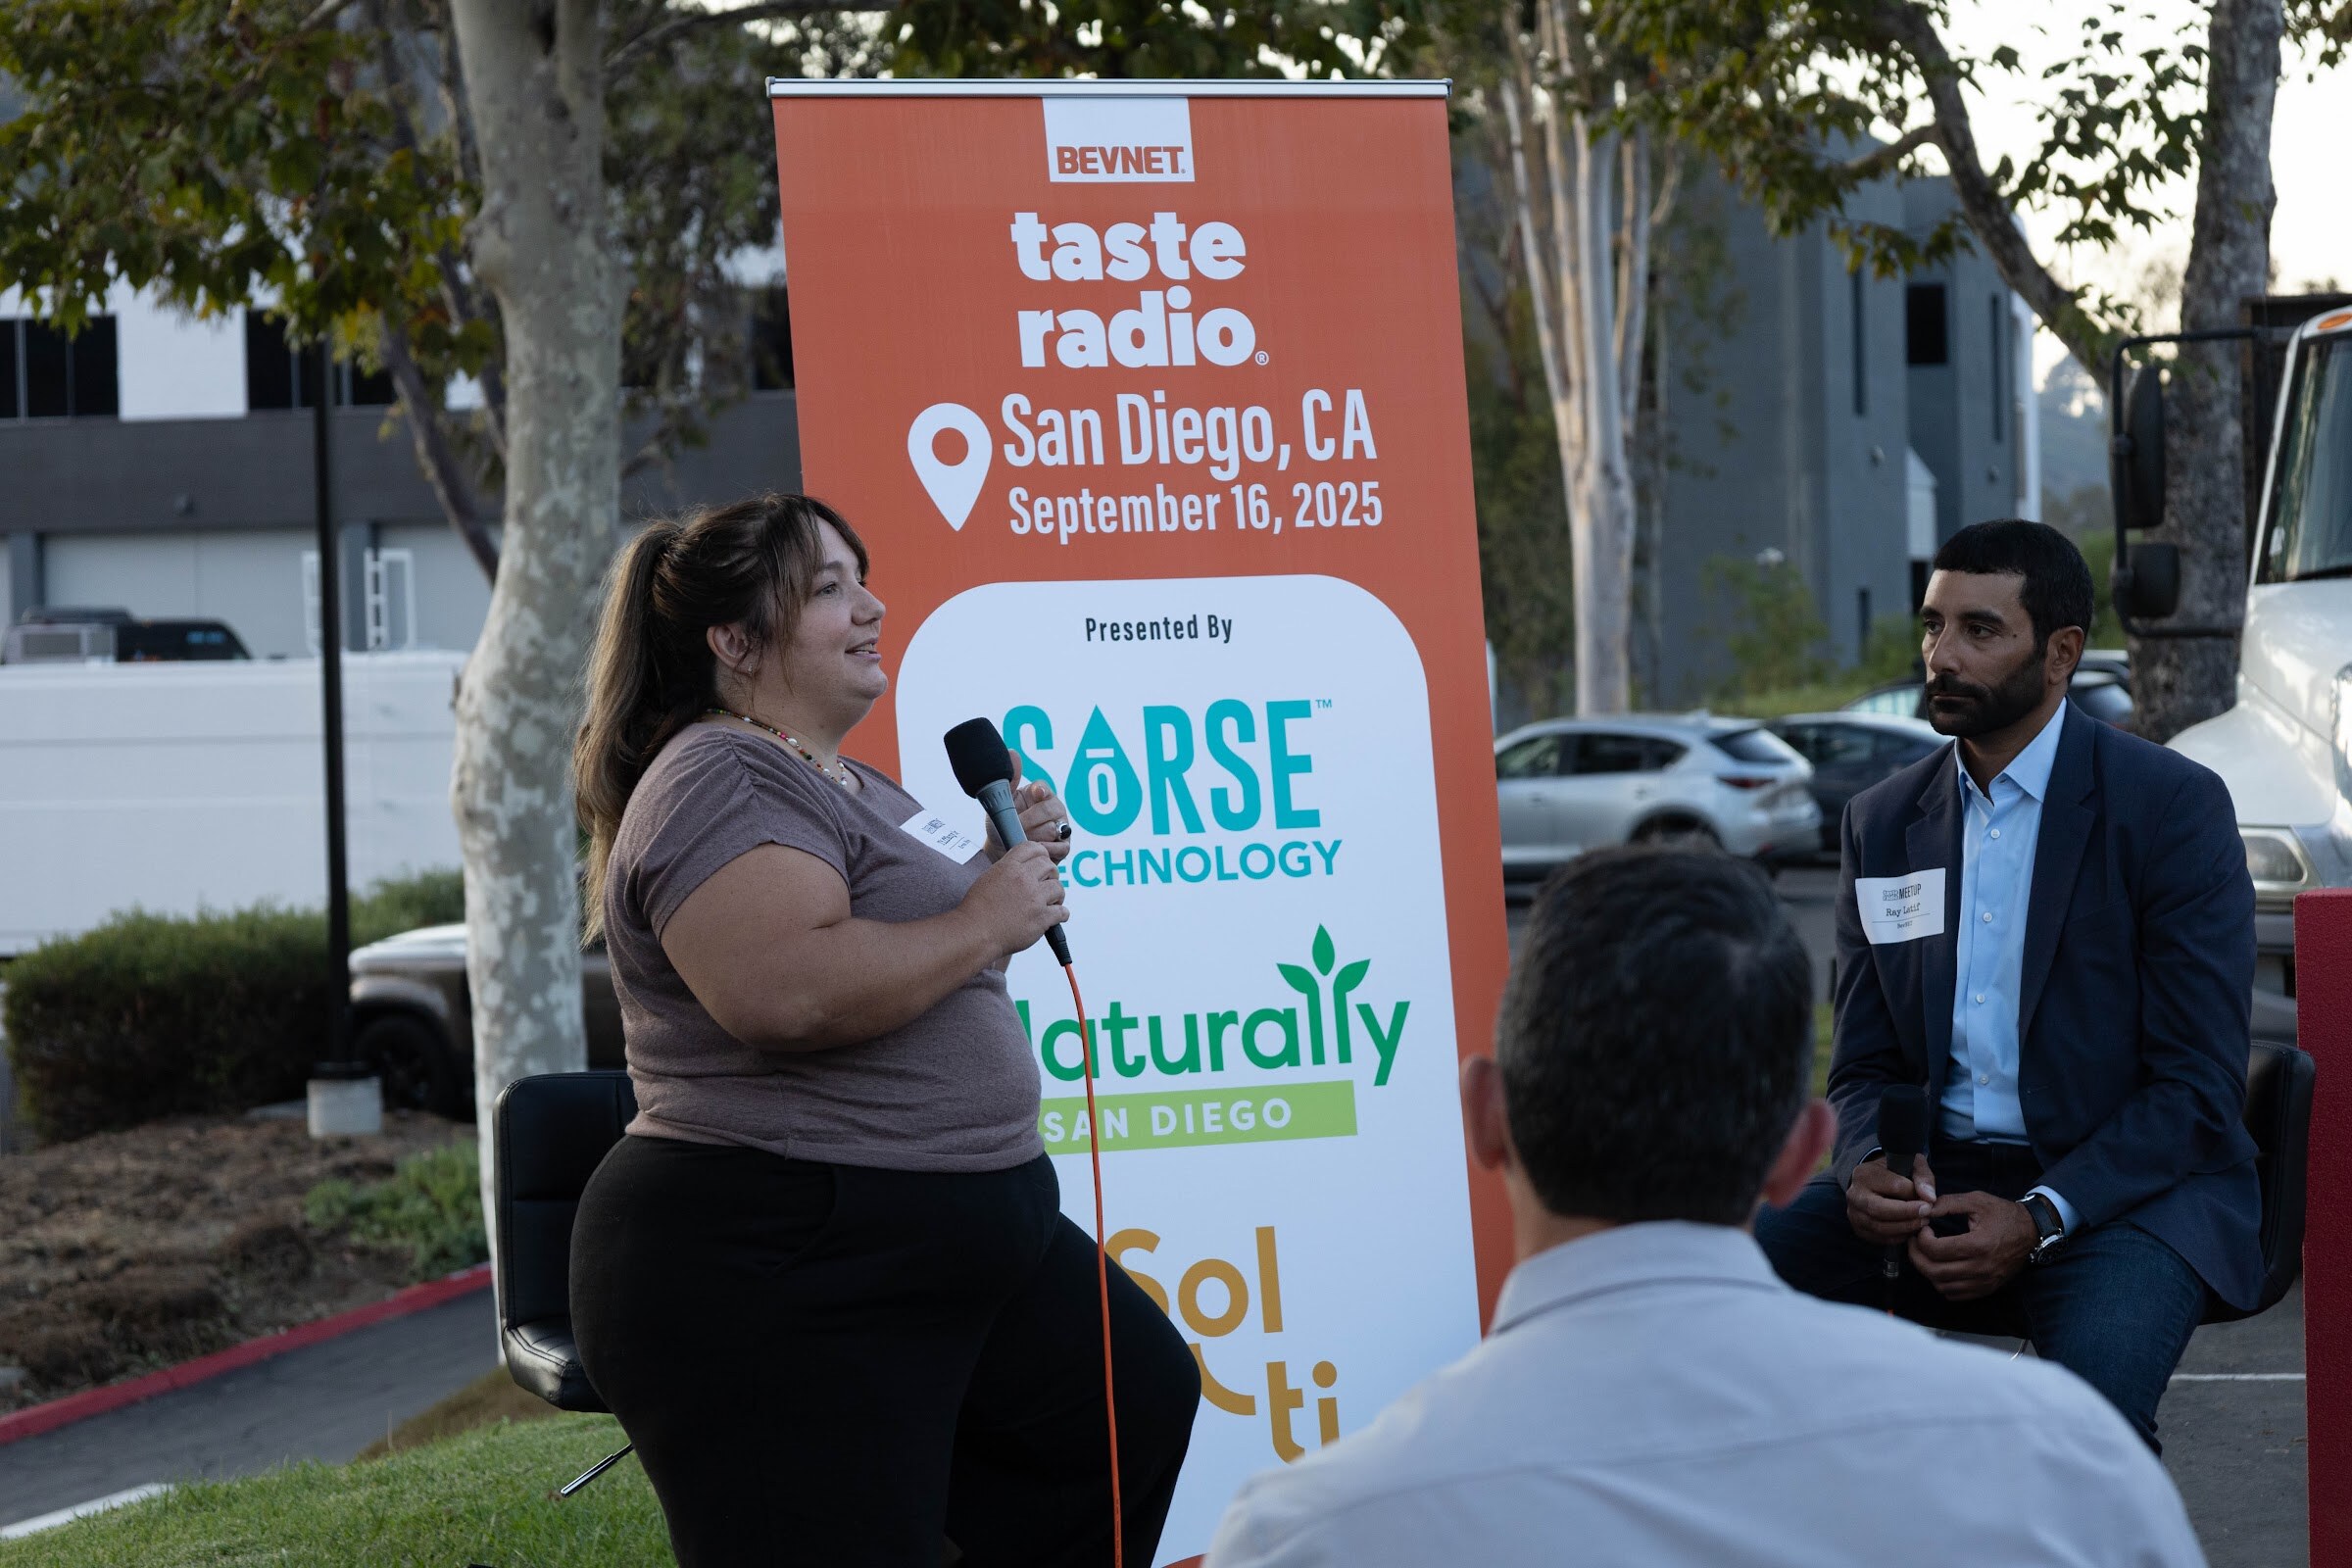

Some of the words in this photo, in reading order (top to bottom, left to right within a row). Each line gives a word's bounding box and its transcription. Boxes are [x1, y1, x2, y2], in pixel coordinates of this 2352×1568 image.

[1010, 212, 1246, 281] taste
[1002, 393, 1104, 467] San
[1117, 390, 1292, 482] Diego,
[1302, 389, 1378, 461] CA
[1009, 484, 1220, 545] September
[1231, 484, 1282, 534] 16,
[1293, 481, 1383, 528] 2025
[1085, 614, 1199, 642] Presented
[1207, 614, 1233, 644] By
[1058, 839, 1343, 888] CHNOLOGY
[1886, 907, 1901, 917] Ray
[1044, 1107, 1129, 1143] SAN
[1151, 1097, 1294, 1138] DIEGO
[1104, 1226, 1284, 1338] Sol
